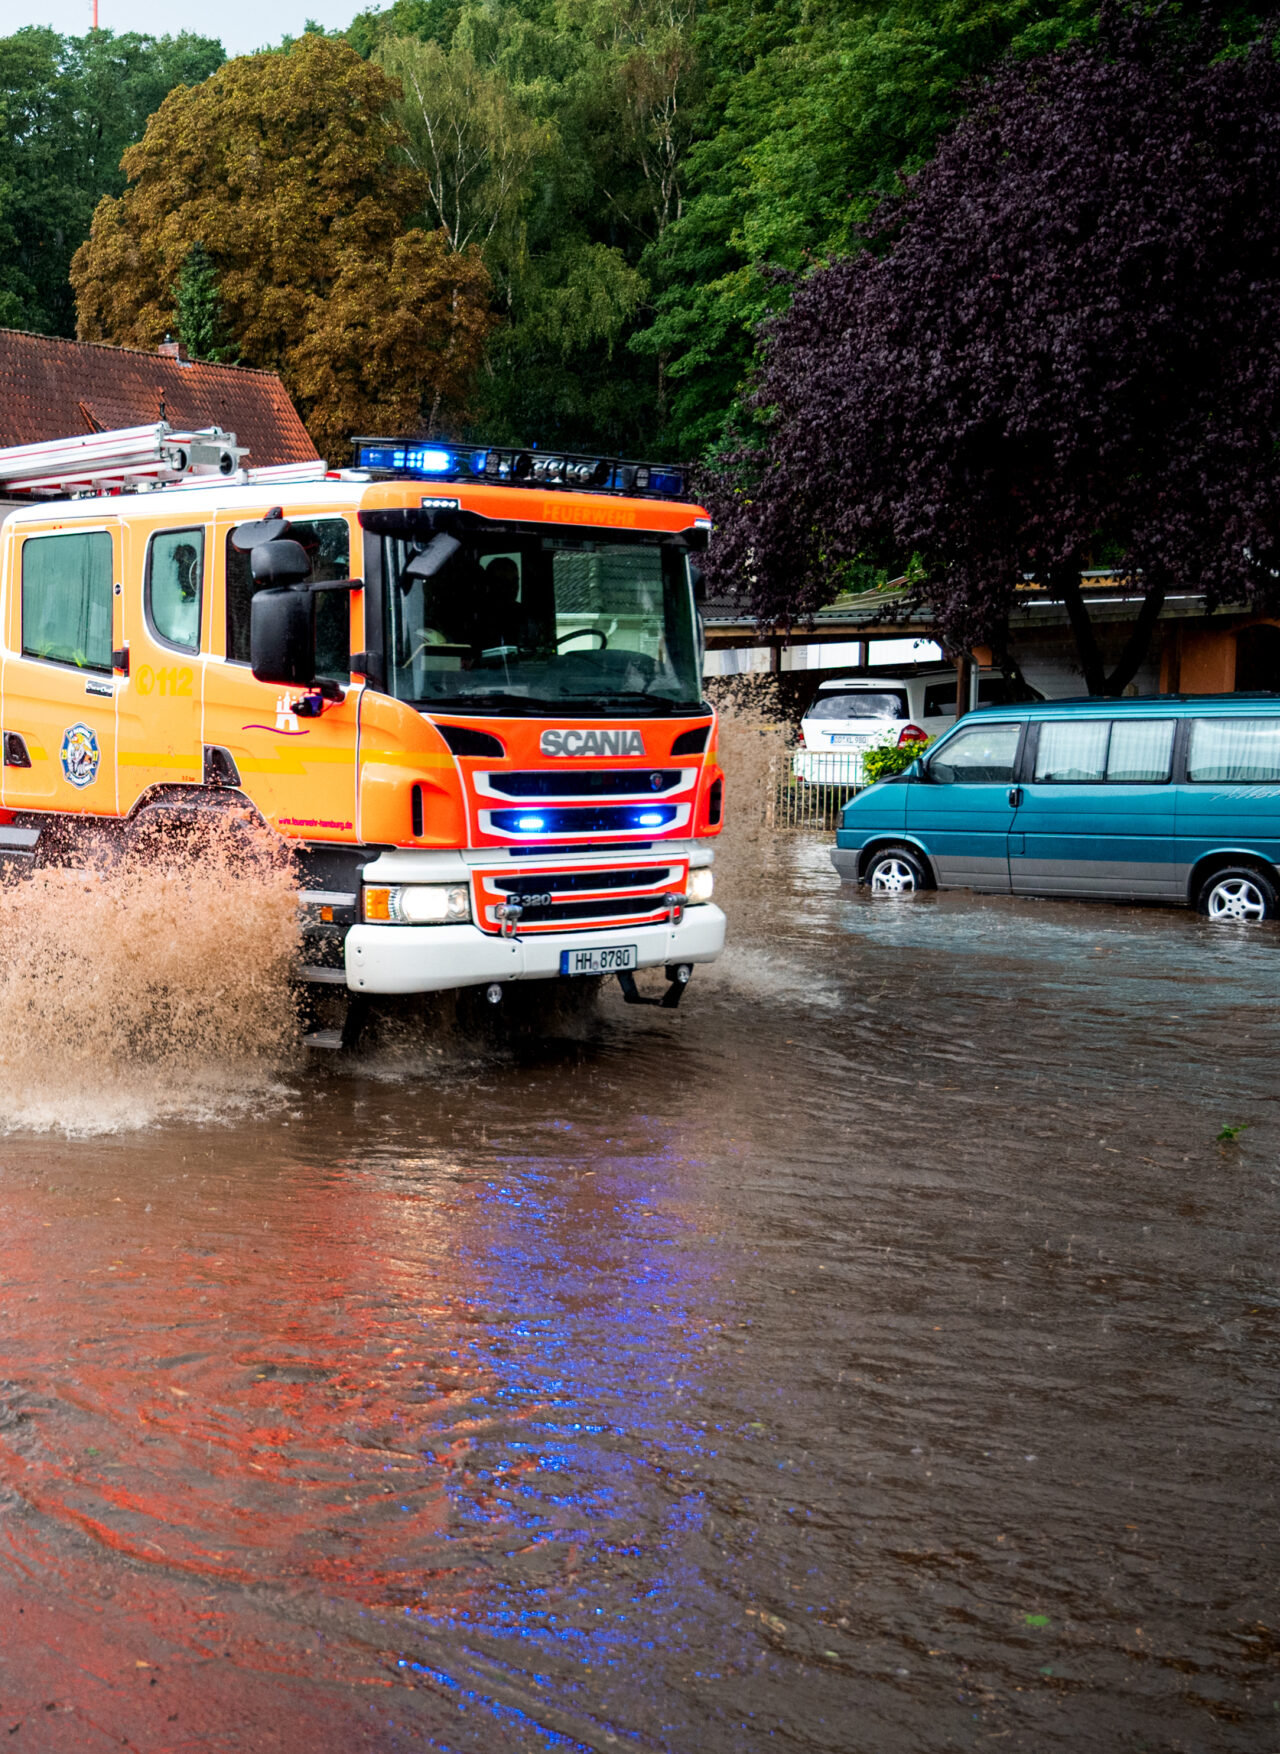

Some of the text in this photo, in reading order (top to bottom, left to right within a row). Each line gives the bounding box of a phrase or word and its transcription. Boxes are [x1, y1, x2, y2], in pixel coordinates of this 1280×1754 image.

[542, 502, 637, 526] FEUERWEHR
[156, 667, 194, 697] 112
[540, 730, 646, 756] SCANIA
[510, 894, 552, 907] P 320
[575, 949, 630, 970] HH 8780
